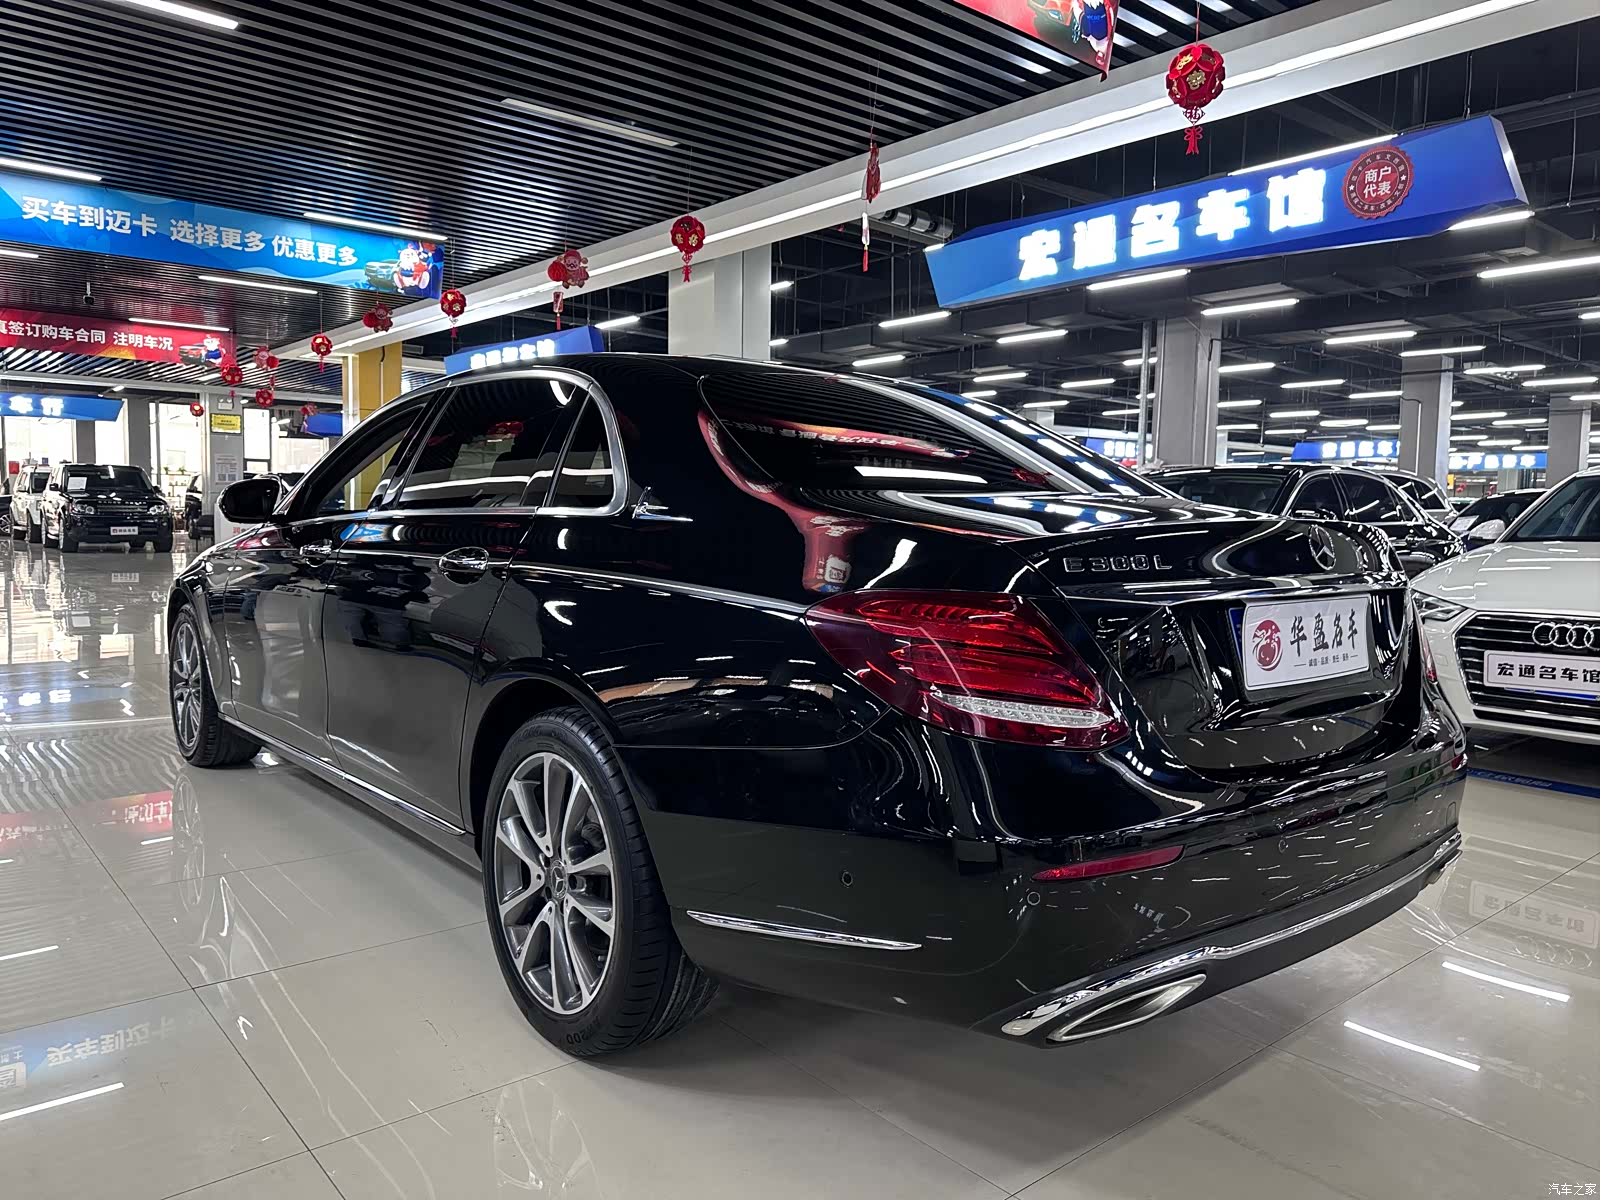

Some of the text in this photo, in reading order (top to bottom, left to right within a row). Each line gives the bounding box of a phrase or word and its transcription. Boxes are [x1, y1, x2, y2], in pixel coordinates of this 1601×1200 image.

[1364, 166, 1392, 184] 商户
[1363, 181, 1392, 198] 代表
[21, 196, 358, 266] 买车到迈卡 选择更多 优惠更多
[113, 332, 173, 351] 注明车况
[1290, 608, 1358, 657] 华盈名车
[1497, 663, 1600, 683] 宏通名车馆
